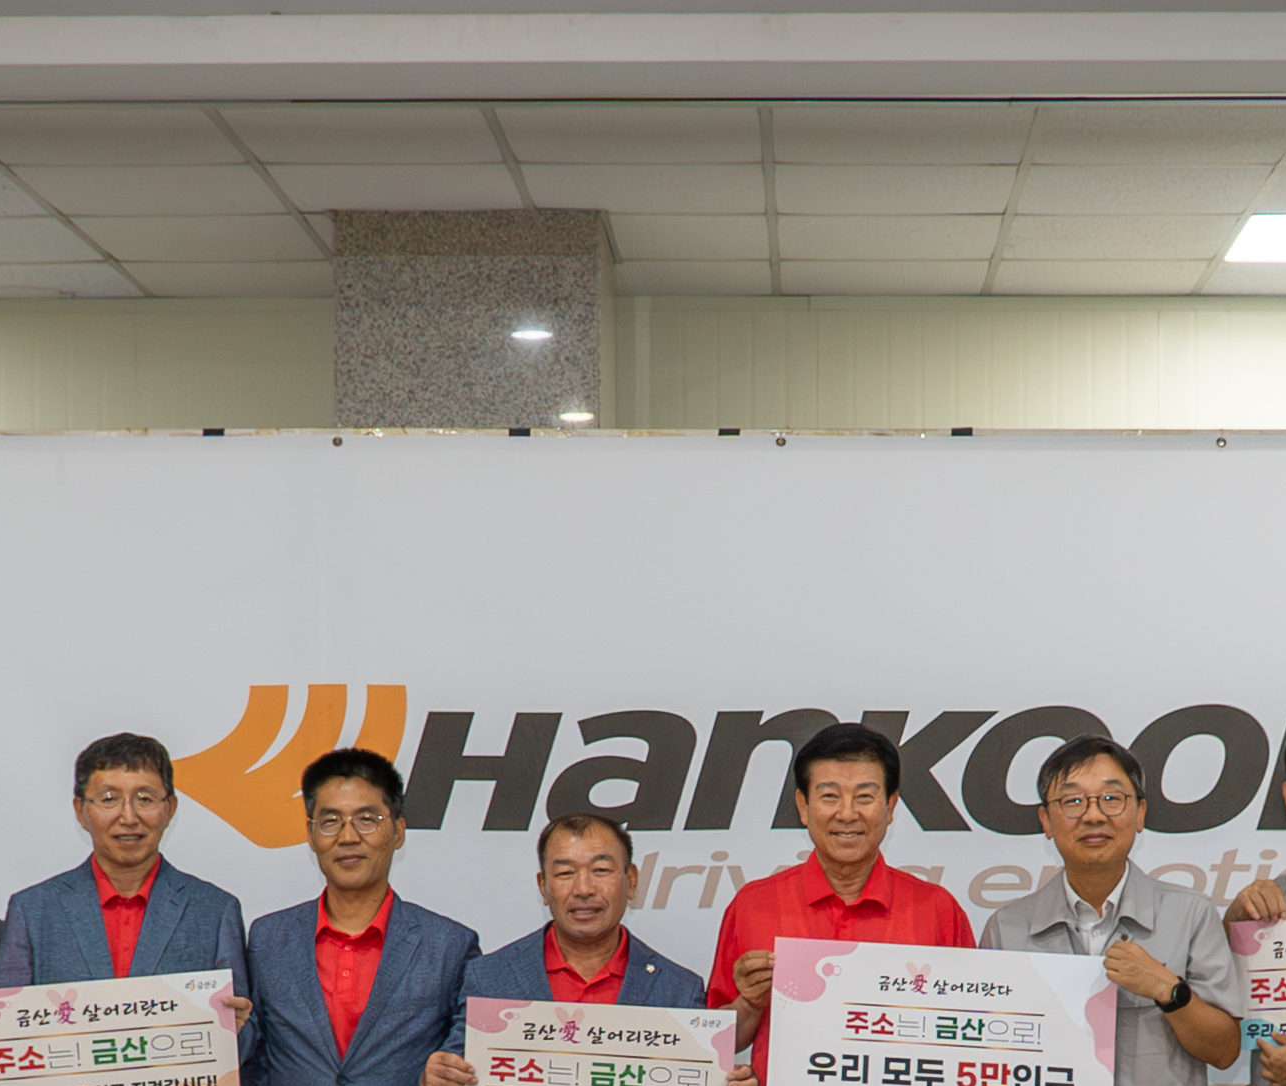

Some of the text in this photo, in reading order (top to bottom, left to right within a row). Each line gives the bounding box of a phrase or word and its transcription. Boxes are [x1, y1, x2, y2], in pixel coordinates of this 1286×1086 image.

[932, 978, 1013, 997] 살어리랏다
[82, 999, 178, 1022] 살어리랏다
[587, 1027, 681, 1047] 살어리랏다
[845, 1010, 1043, 1045] 주소는! 금산으로!
[1247, 1023, 1274, 1038] 우리
[91, 1031, 212, 1065] 금산으로!
[489, 1056, 579, 1086] 주소는!
[806, 1052, 870, 1084] 우리
